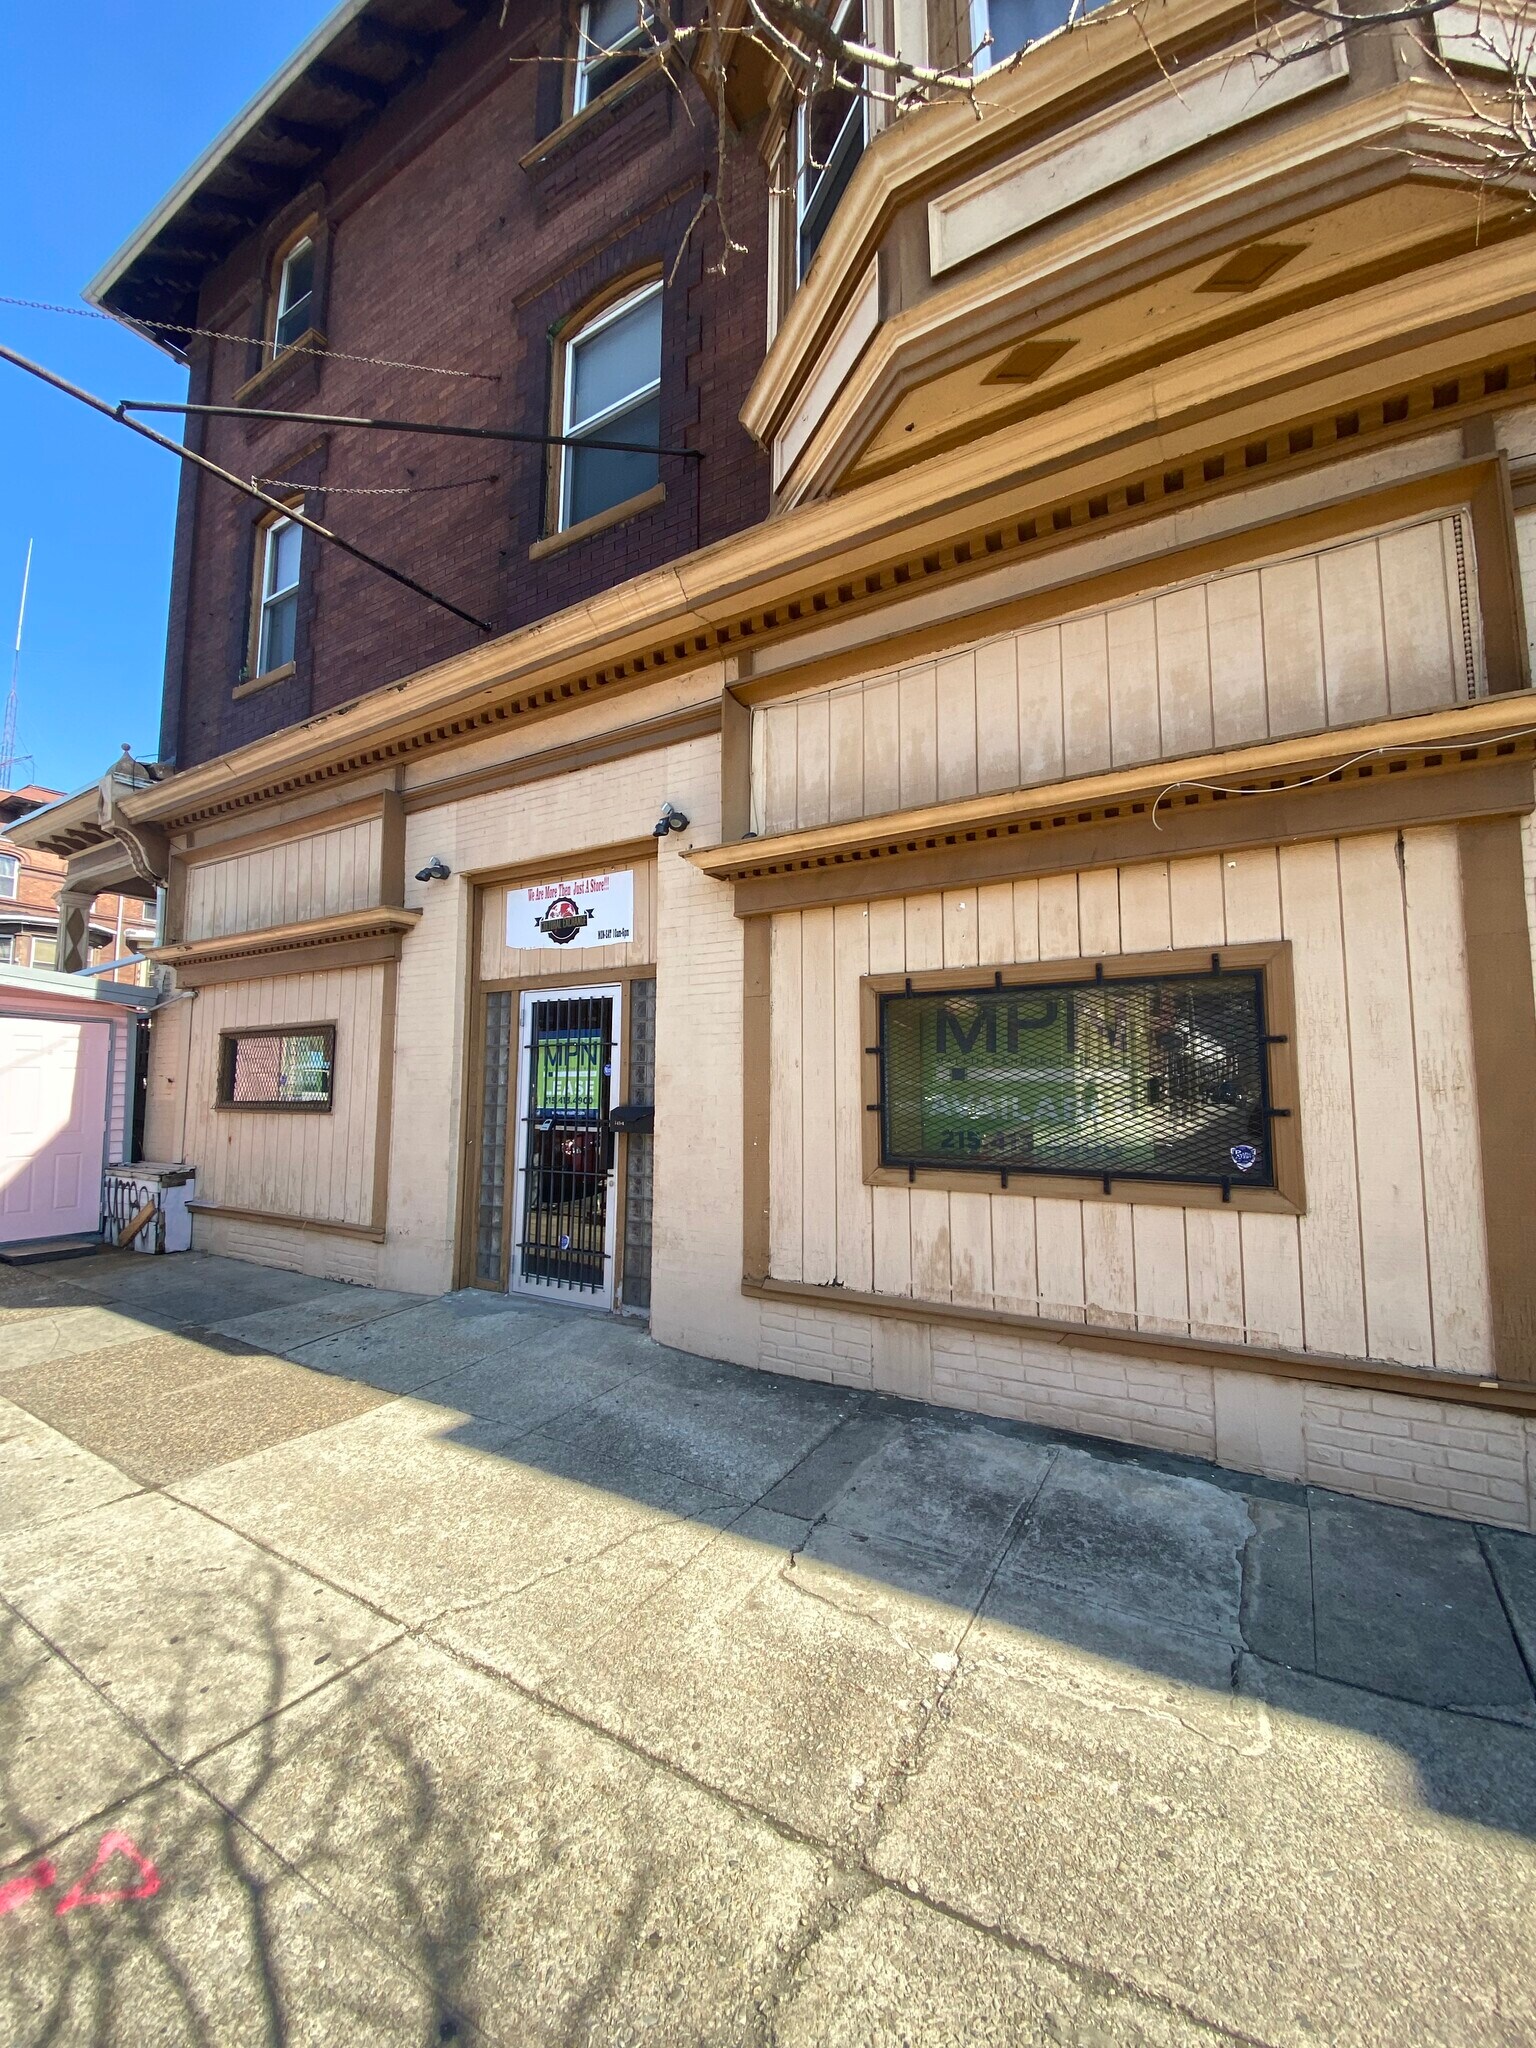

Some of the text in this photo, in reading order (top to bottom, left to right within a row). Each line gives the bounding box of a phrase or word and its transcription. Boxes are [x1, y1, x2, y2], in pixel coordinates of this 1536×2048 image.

[528, 889, 535, 901] We
[535, 888, 544, 900] Are
[545, 886, 557, 899] More
[573, 882, 584, 895] Just
[585, 880, 589, 893] A
[544, 1041, 597, 1066] MPN
